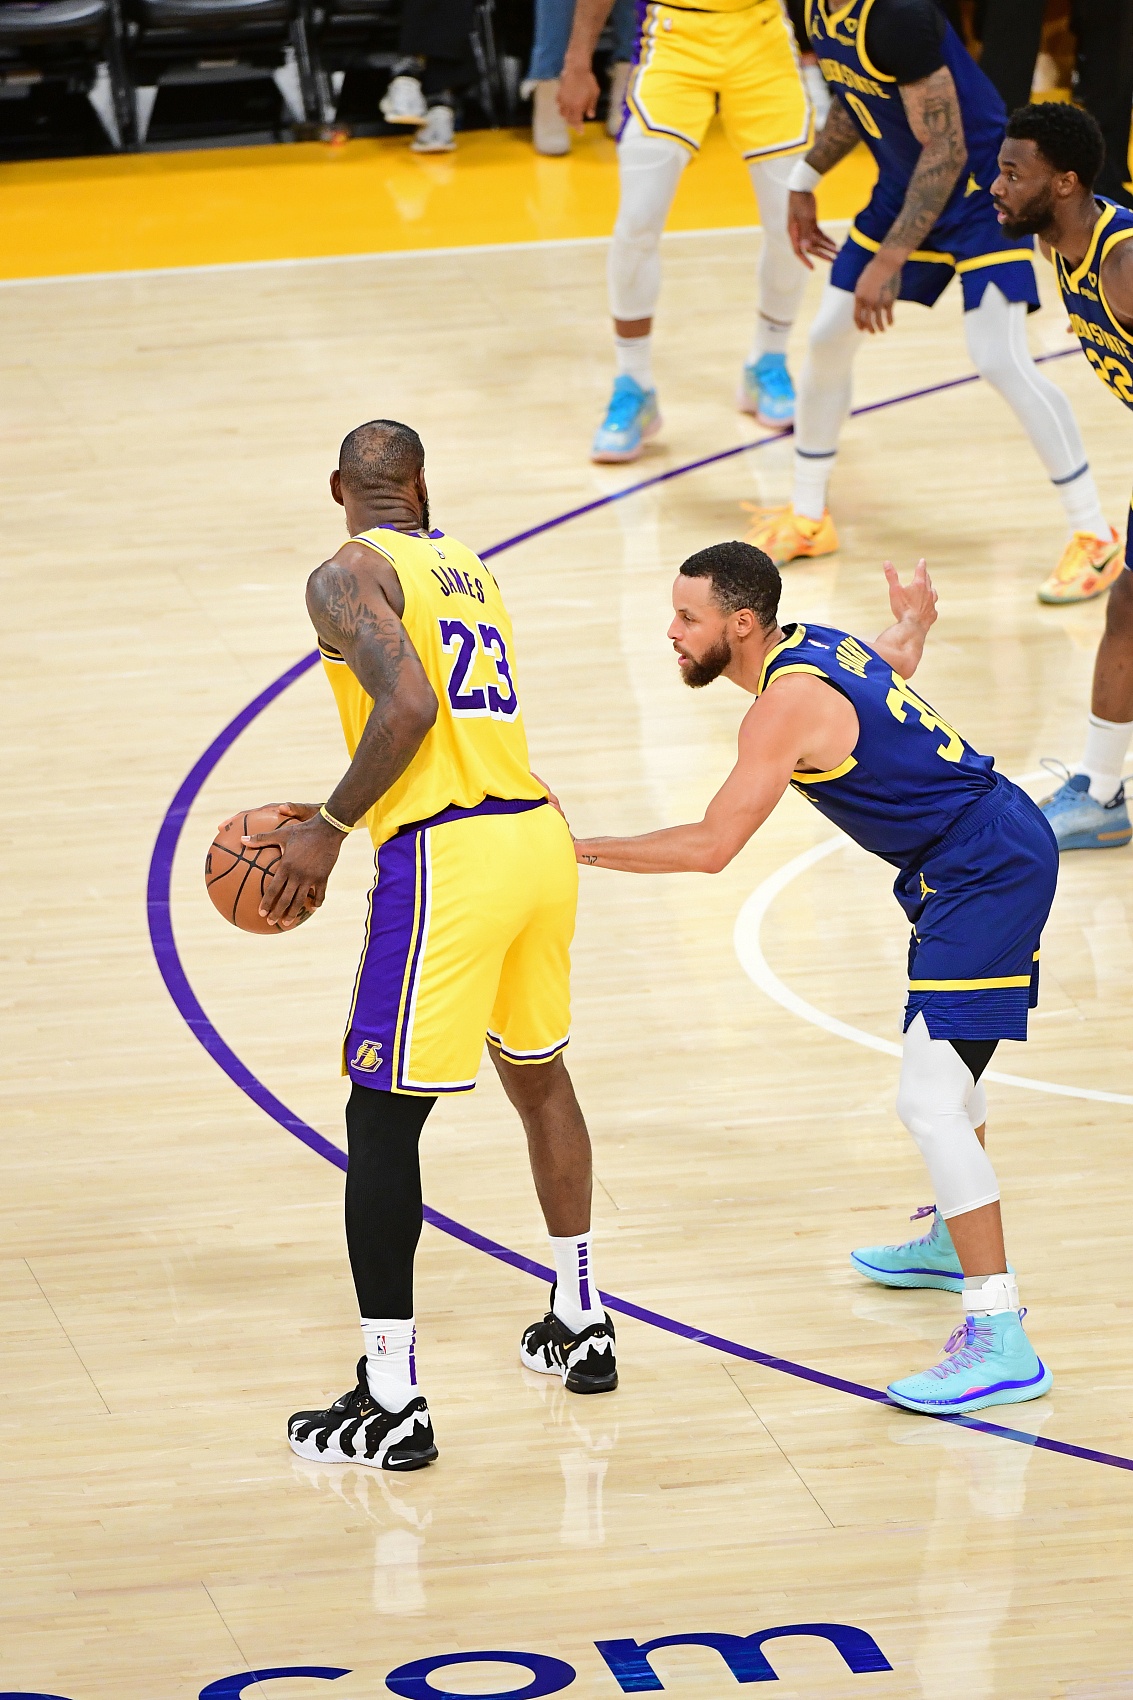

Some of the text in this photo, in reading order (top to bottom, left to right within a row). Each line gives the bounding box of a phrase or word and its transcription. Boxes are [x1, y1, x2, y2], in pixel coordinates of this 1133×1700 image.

[844, 91, 883, 140] 0
[430, 566, 485, 604] JAMES
[437, 617, 520, 724] 23
[835, 636, 873, 679] CURRY
